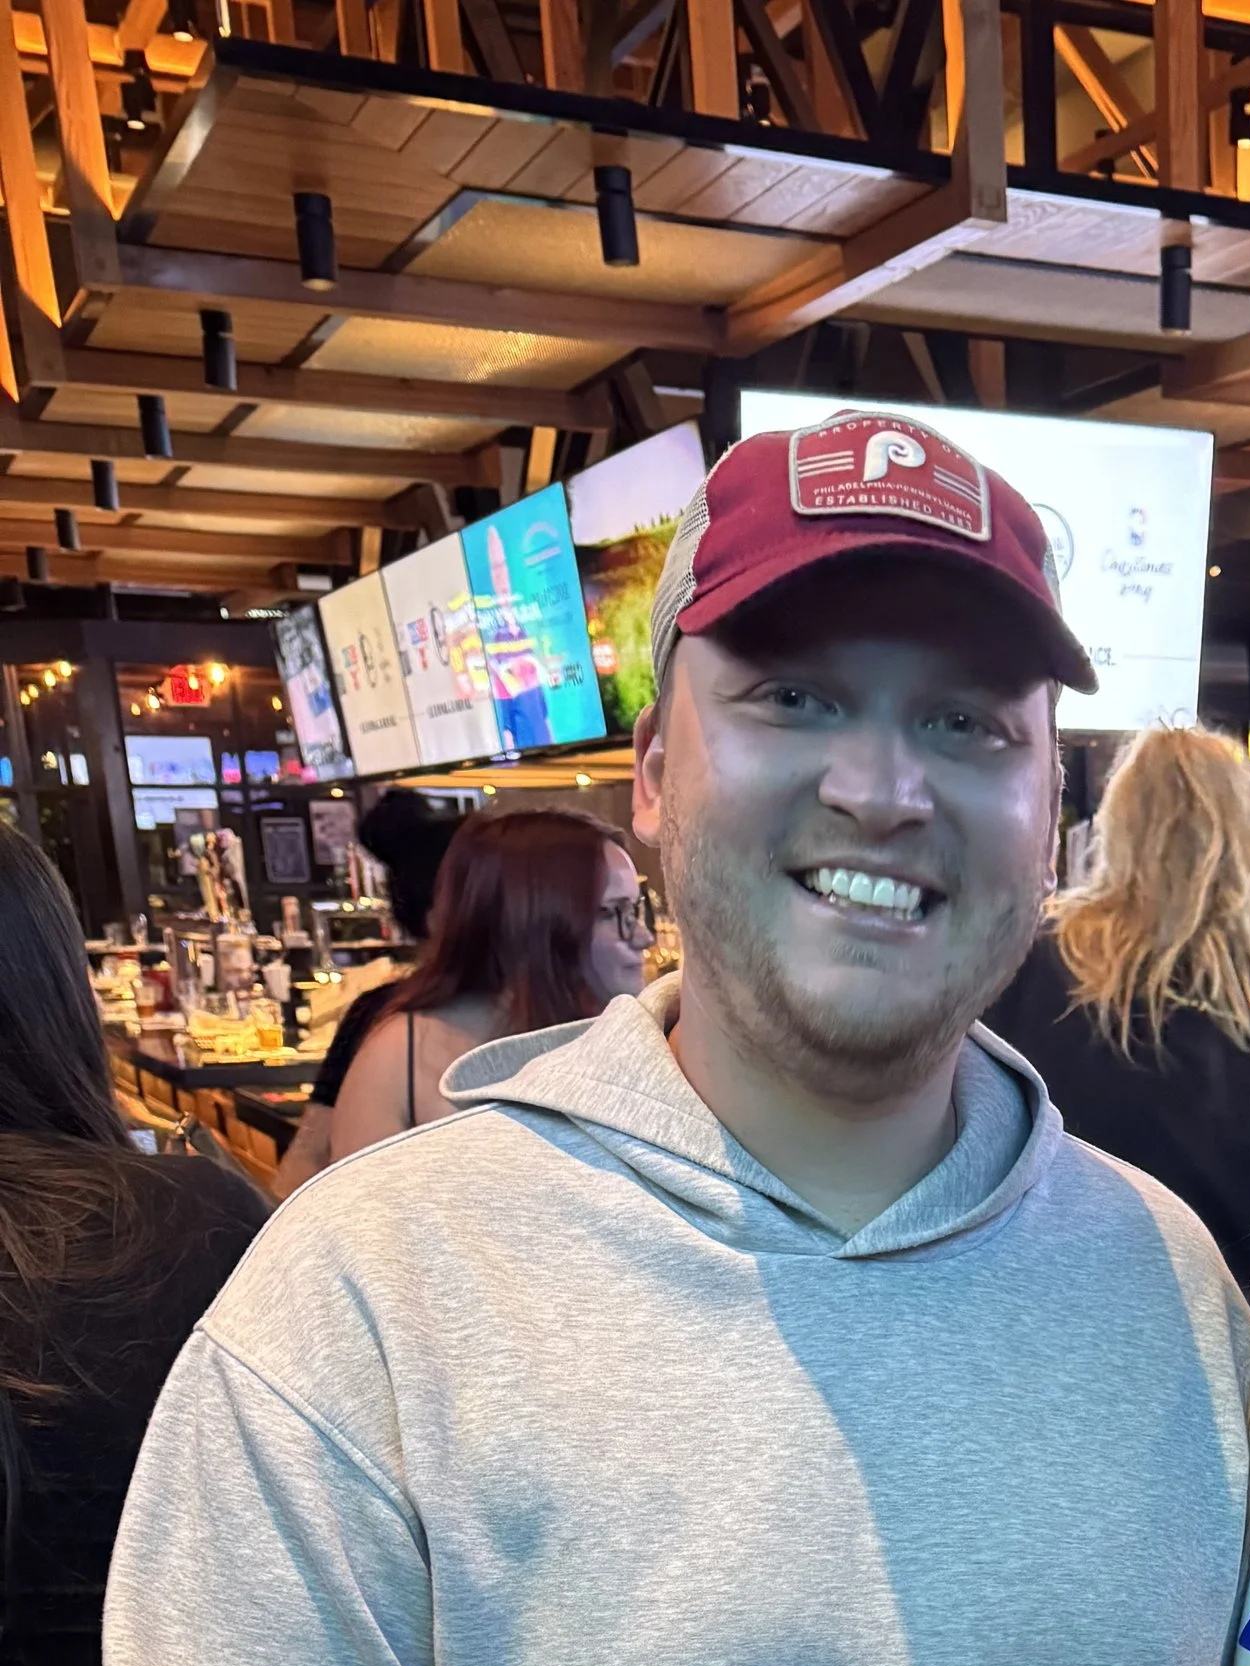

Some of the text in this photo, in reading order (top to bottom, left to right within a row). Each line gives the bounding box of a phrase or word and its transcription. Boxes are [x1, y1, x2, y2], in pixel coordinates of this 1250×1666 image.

[818, 420, 929, 439] PROPERTY
[863, 430, 926, 482] P
[815, 494, 973, 531] ESTABLISHED 1883
